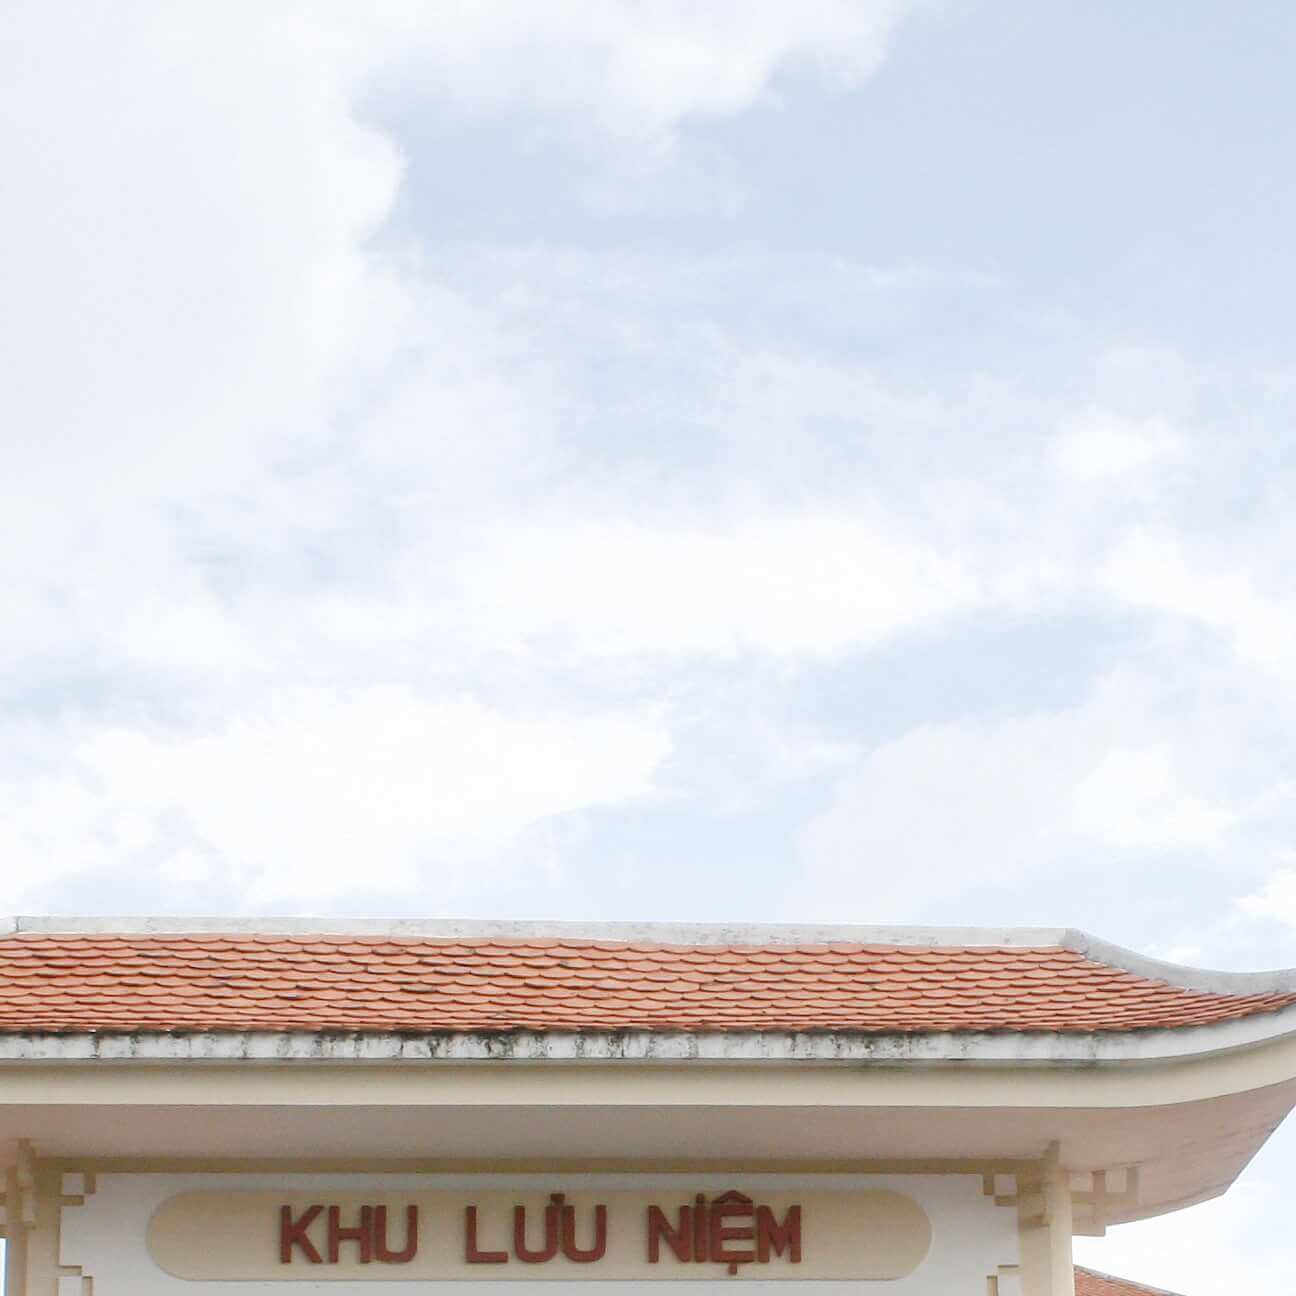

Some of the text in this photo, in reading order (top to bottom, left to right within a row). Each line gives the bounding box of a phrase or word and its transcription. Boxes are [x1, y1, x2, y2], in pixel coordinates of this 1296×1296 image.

[280, 1189, 802, 1275] KHU LƯU NIỆM
